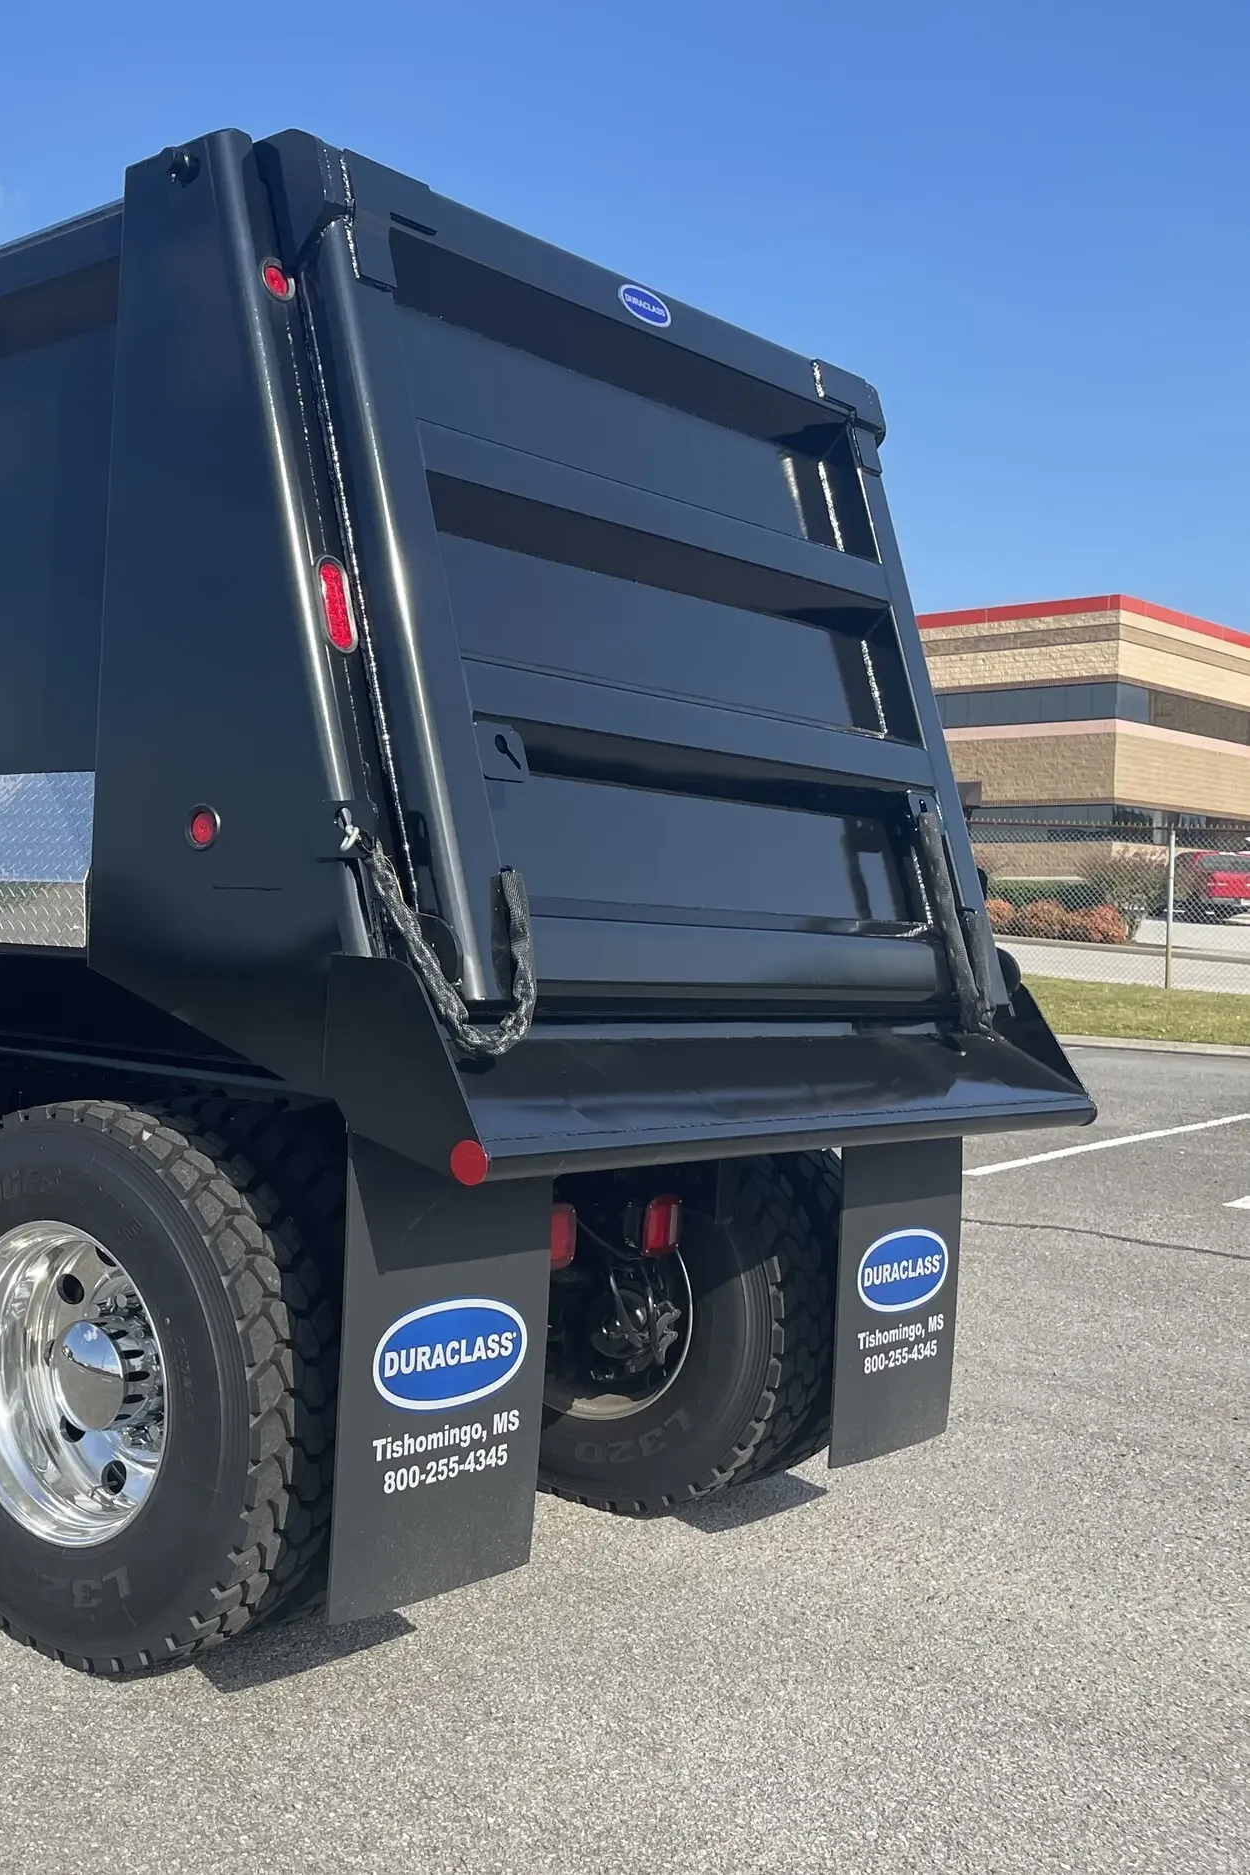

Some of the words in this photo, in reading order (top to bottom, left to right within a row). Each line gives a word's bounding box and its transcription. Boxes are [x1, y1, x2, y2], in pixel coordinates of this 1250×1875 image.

[624, 293, 666, 317] DURACLASS
[863, 1254, 941, 1288] DURACLASS
[857, 1322, 926, 1350] Tishomingo,
[928, 1313, 944, 1333] MS
[383, 1331, 515, 1378] DURACLASS
[863, 1340, 938, 1375] 800-255-4345
[372, 1422, 488, 1462] Tishomingo,
[493, 1409, 520, 1436] MS
[382, 1444, 509, 1495] 800-255-4345
